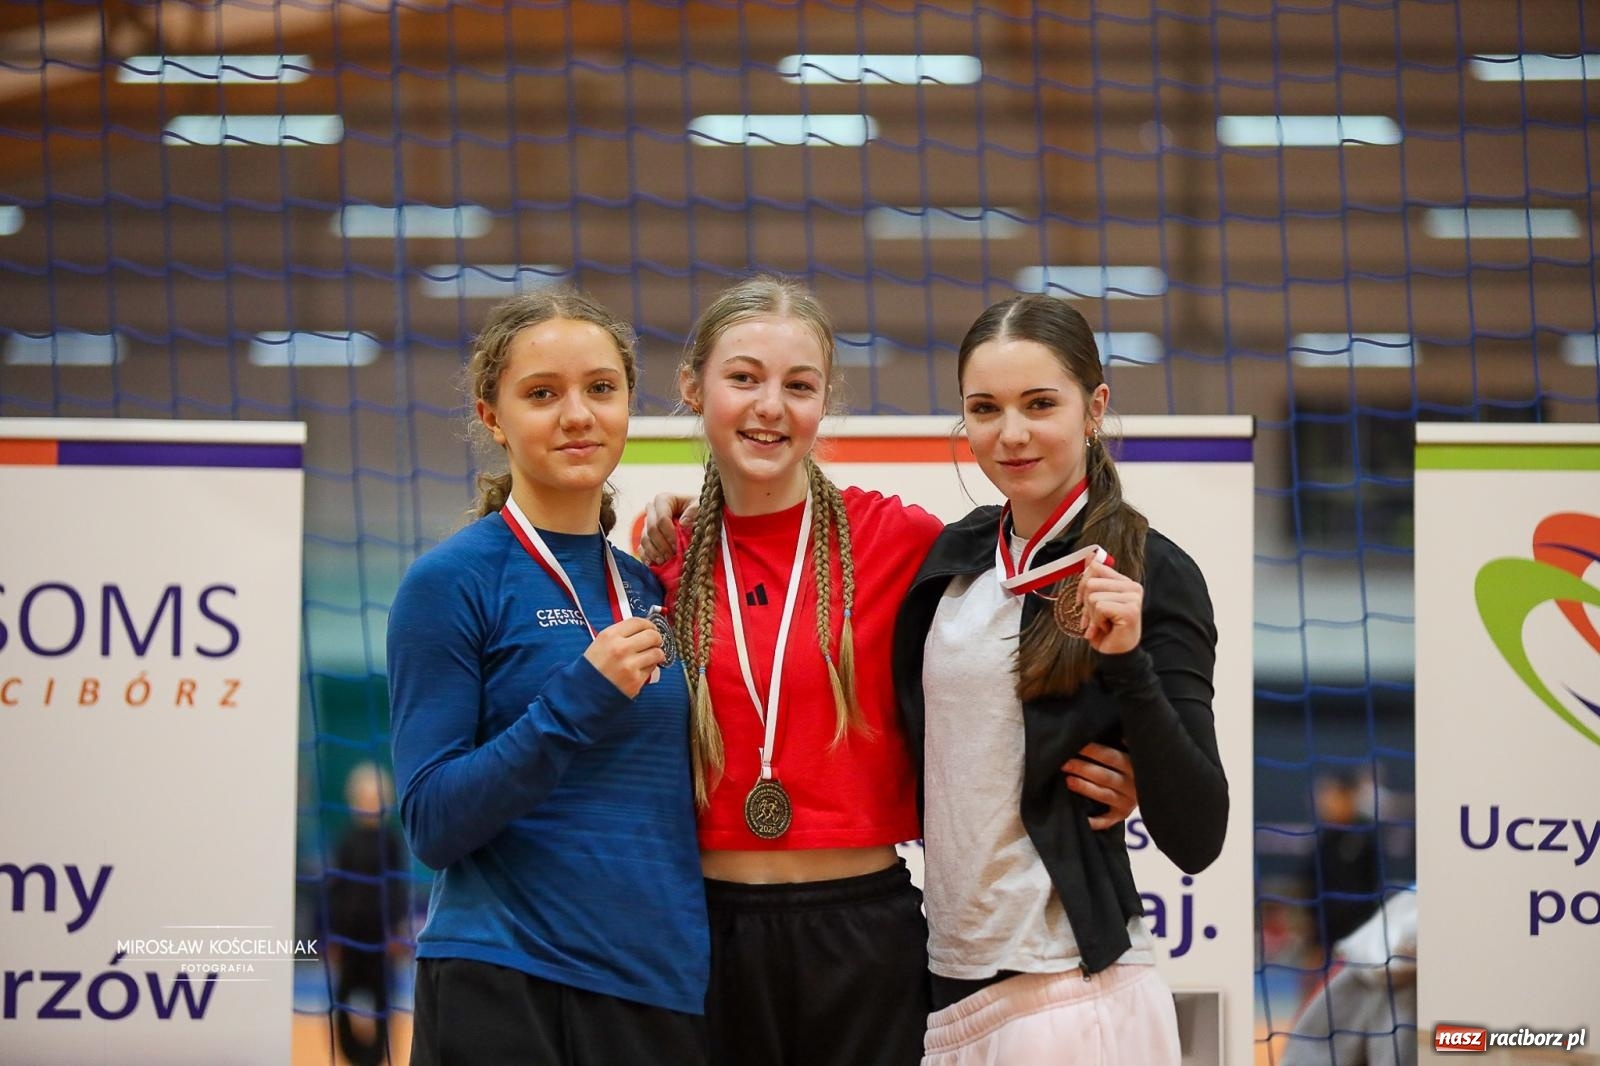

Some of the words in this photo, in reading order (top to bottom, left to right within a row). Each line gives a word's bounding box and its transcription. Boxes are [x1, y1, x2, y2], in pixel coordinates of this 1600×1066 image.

[0, 582, 240, 658] OMS
[1460, 805, 1600, 866] Uczy
[0, 863, 113, 934] my
[1530, 890, 1600, 936] po
[3, 951, 218, 1020] rzów
